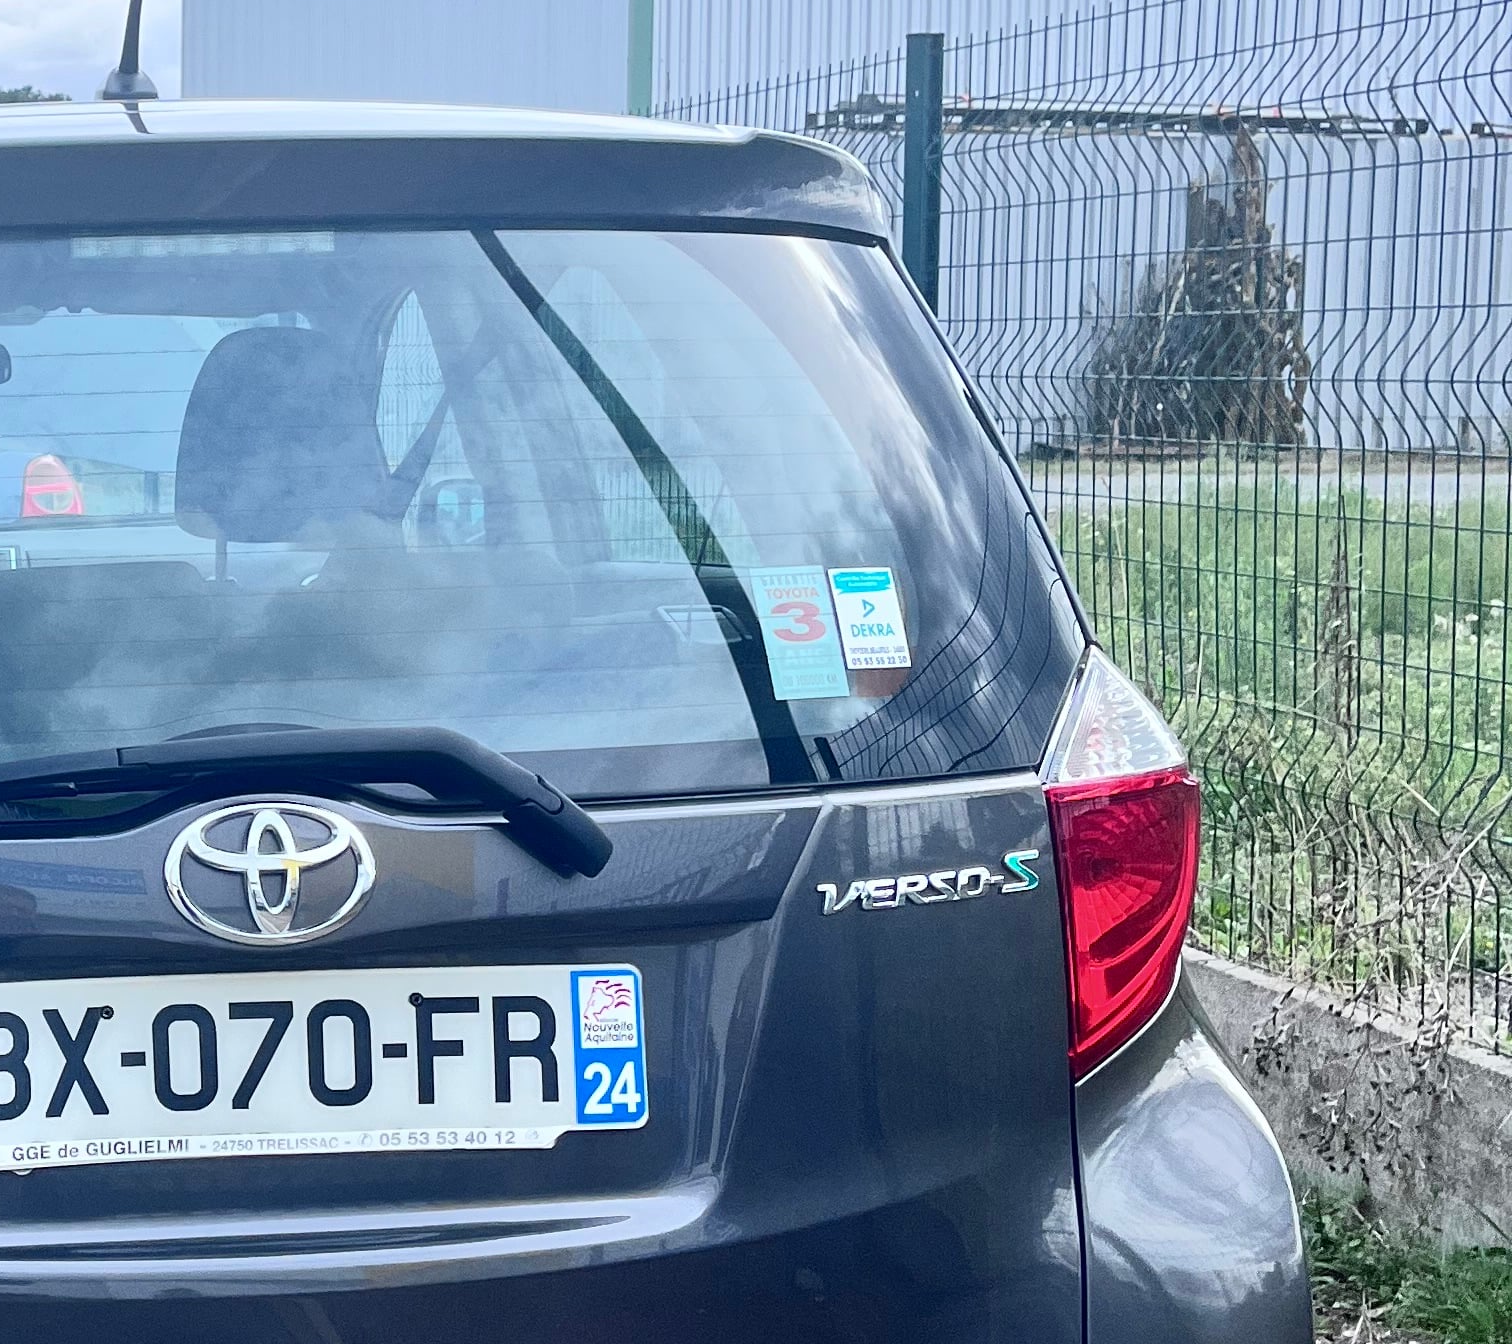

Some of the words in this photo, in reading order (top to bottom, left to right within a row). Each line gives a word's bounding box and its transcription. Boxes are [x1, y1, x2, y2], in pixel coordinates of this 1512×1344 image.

[764, 587, 820, 599] TOYOTA
[771, 601, 826, 642] 3
[850, 623, 895, 637] DEKRA
[817, 849, 1039, 916] VERSO-S
[584, 1021, 634, 1032] Nouvelle
[584, 1032, 634, 1045] Aquitaine
[583, 1061, 641, 1114] 24
[12, 1145, 51, 1161] GGE
[58, 1143, 79, 1158] de
[86, 1138, 189, 1157] GUGLIELMI
[212, 1139, 253, 1152] 24750
[257, 1135, 338, 1151] TRELISSAC
[379, 1132, 401, 1146] 05
[407, 1131, 430, 1146] 53
[436, 1131, 458, 1145] 53
[464, 1130, 486, 1145] 40
[495, 1130, 516, 1145] 12
